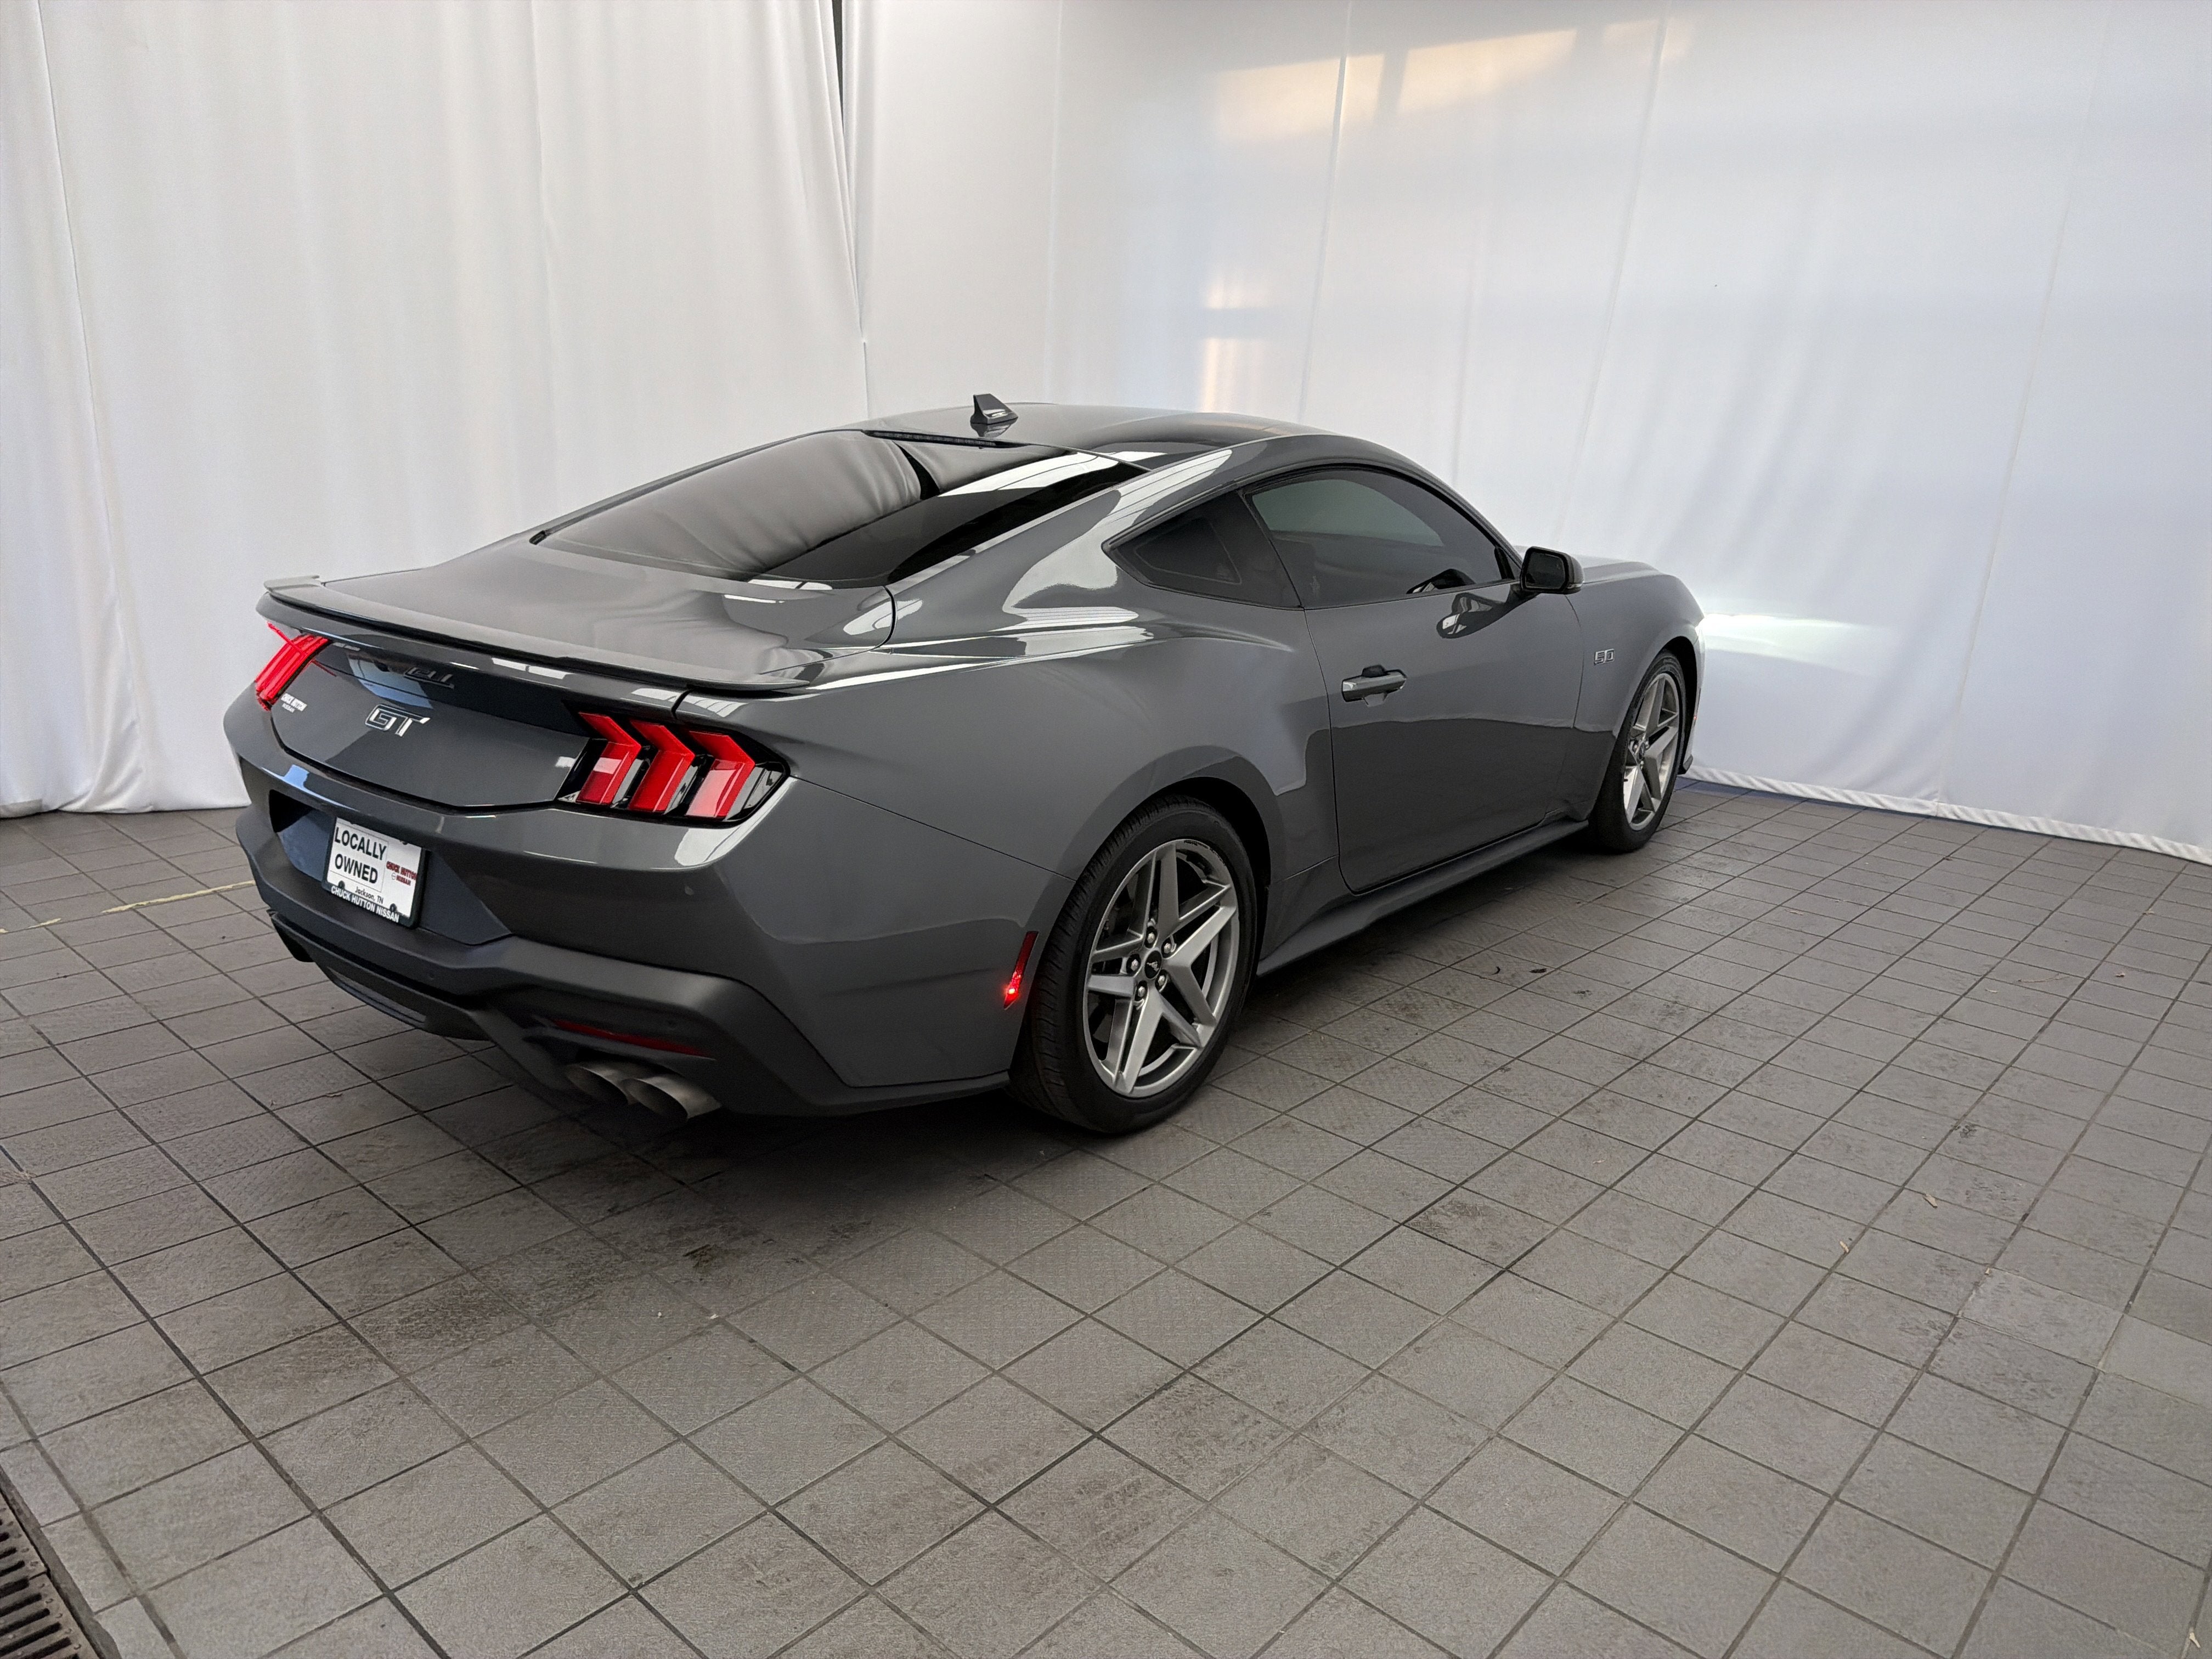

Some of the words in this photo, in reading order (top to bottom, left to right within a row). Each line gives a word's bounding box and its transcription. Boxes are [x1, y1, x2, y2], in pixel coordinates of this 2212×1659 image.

[365, 704, 430, 737] GT
[335, 826, 387, 860] LOCALLY
[335, 854, 378, 883] OWNED
[331, 885, 351, 901] CHUCK
[351, 894, 375, 912] HUTTON
[376, 906, 399, 923] NISSAN
[355, 886, 376, 901] Jackson,
[377, 895, 384, 905] TN
